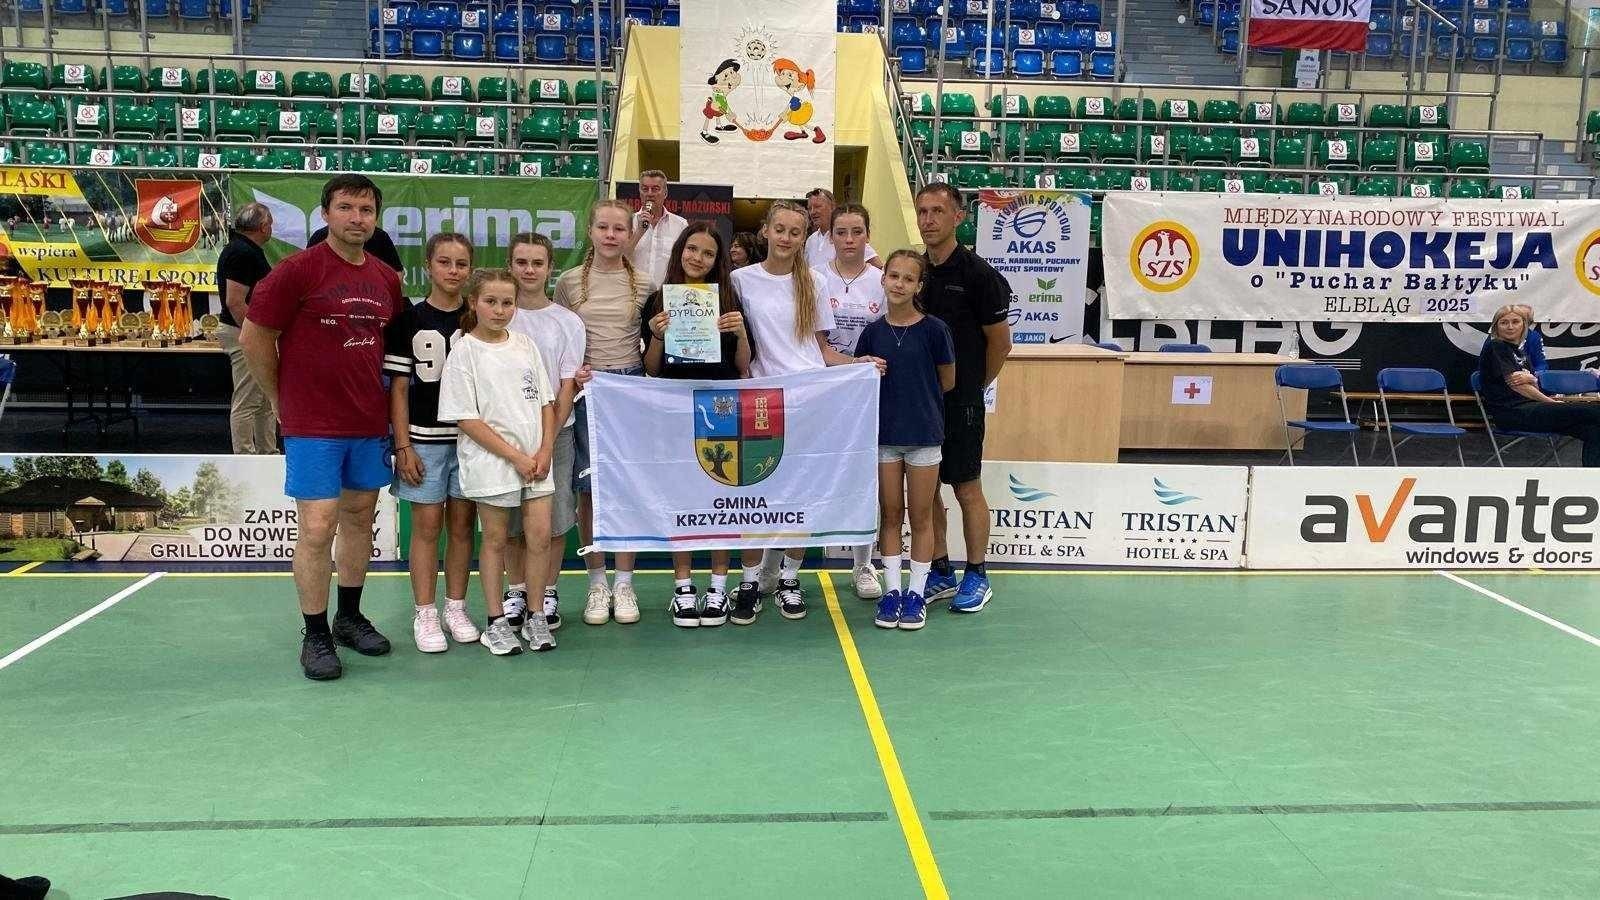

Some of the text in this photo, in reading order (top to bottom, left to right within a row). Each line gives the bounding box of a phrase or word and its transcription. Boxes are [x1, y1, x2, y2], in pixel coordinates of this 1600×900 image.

[1262, 0, 1357, 17] SANOK
[382, 196, 577, 250] erima
[992, 194, 1071, 241] HURTOWNIA SPORTOWA
[1223, 208, 1564, 228] MIĘDZYNARODOWY FESTIWAL
[18, 245, 77, 260] wspiera
[1007, 241, 1056, 253] AKAS
[1223, 228, 1558, 269] UNIHOKEJA
[1146, 260, 1184, 277] SZS
[1250, 272, 1529, 295] o "Puchar Bałtyku"
[1028, 292, 1063, 303] erima
[669, 309, 714, 318] DYPLOM
[1324, 296, 1470, 317] ELBLĄG 2025
[1024, 312, 1059, 322] AKAS
[1024, 333, 1044, 342] JAKO
[713, 497, 767, 510] GMINA
[676, 510, 804, 527] KRZYŻANOWICE
[1121, 512, 1238, 533] TRISTAN
[204, 528, 235, 541] DO
[150, 544, 266, 558] GRILLOWEJ
[1040, 545, 1053, 558] &
[1056, 545, 1085, 558] SPA
[1126, 547, 1229, 561] HOTEL & SPA
[1406, 547, 1593, 564] windows & doors
